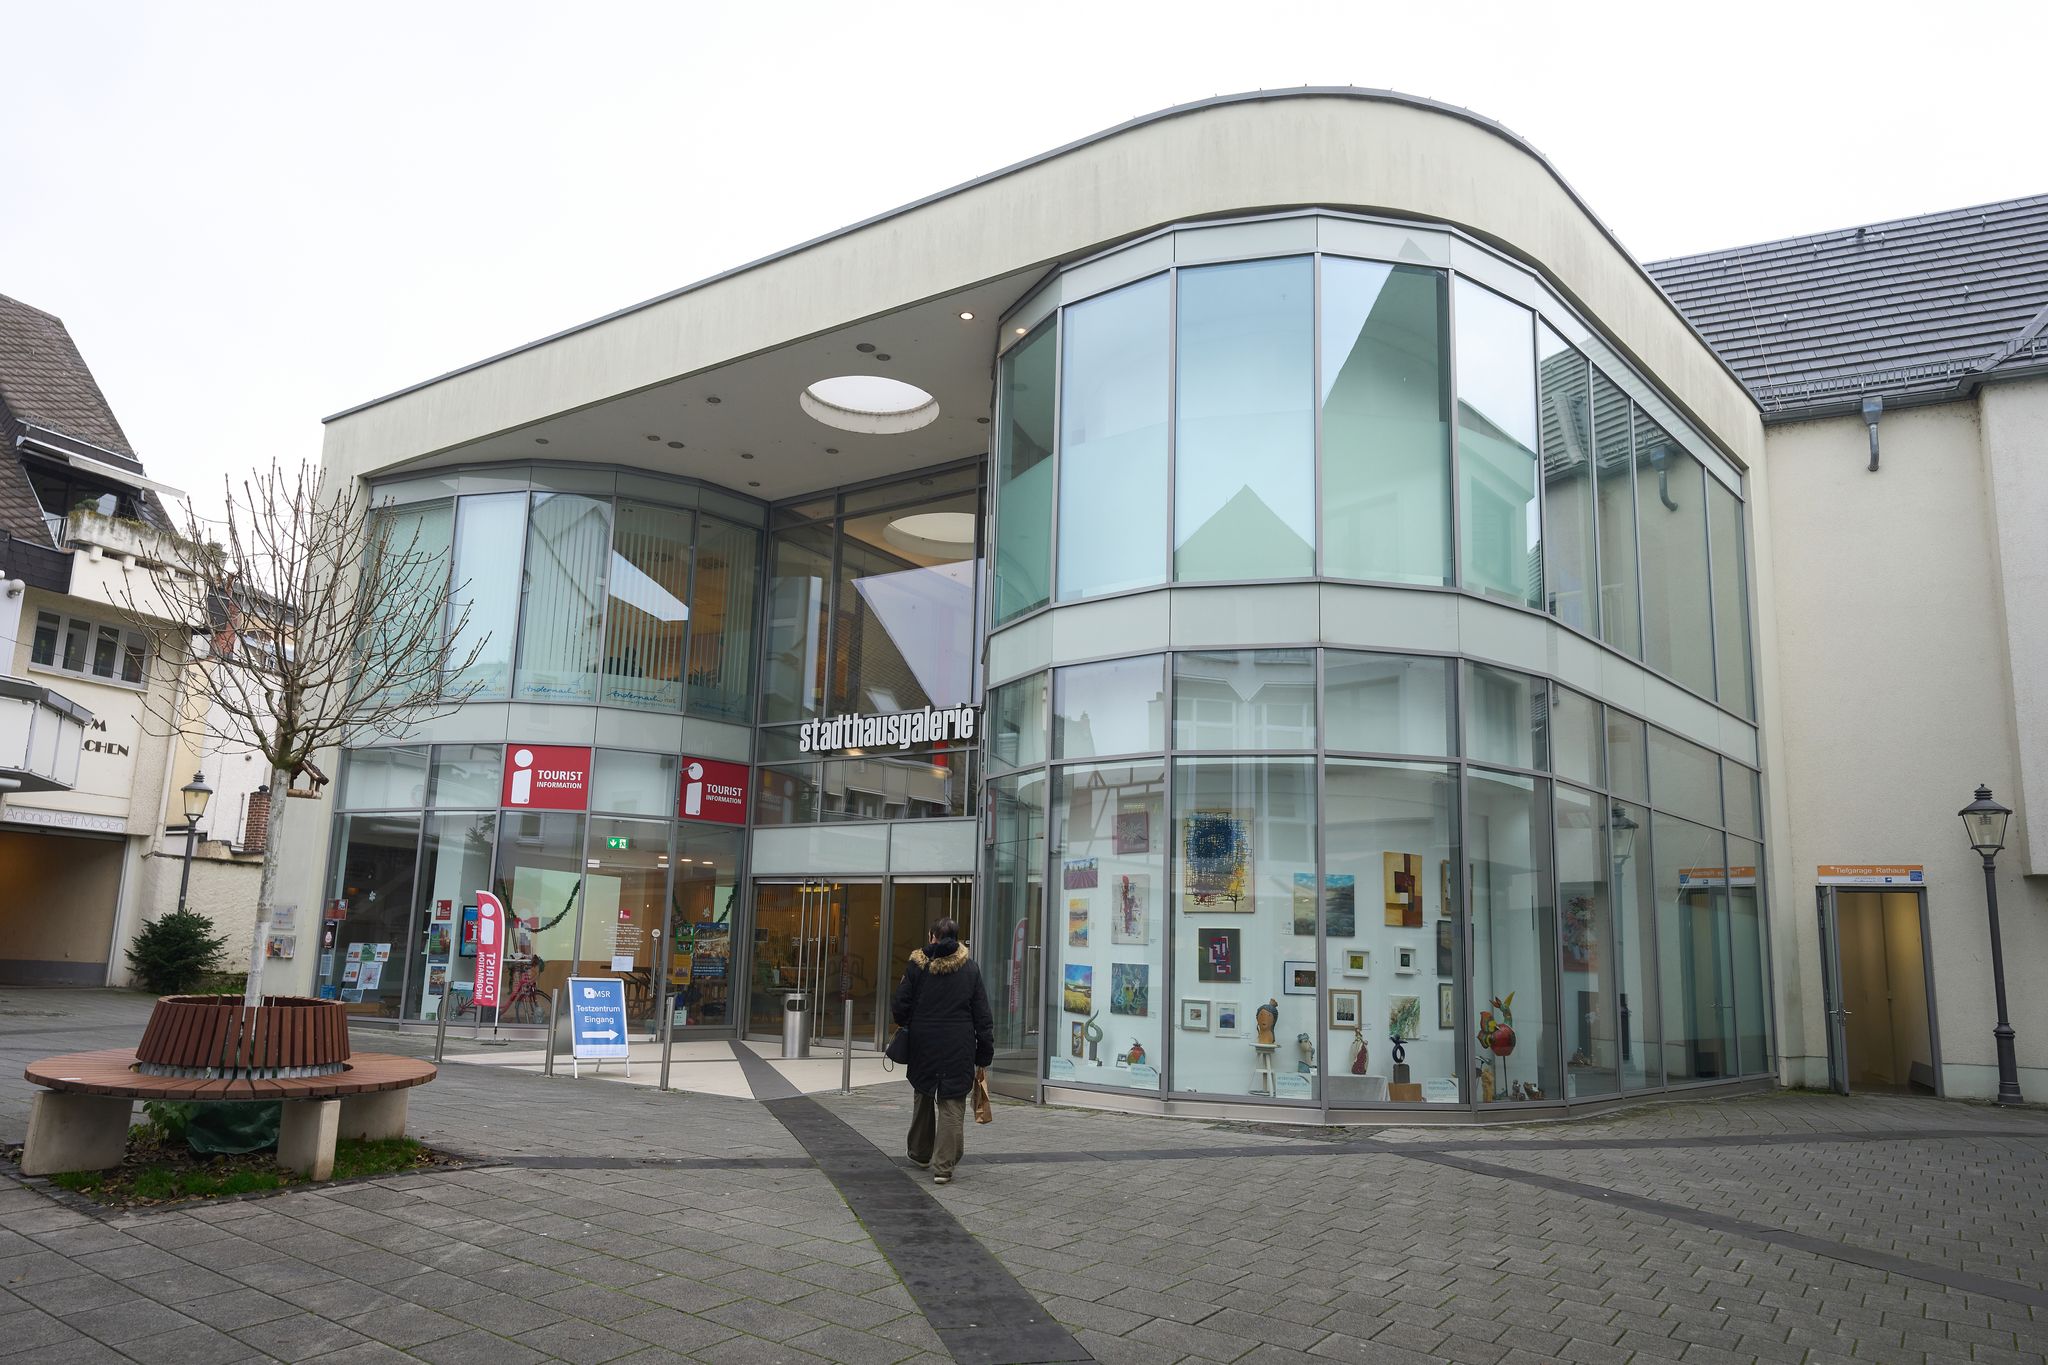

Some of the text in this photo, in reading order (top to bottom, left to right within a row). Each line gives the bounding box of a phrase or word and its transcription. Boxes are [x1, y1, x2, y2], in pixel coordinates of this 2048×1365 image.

[90, 717, 107, 732] M
[800, 702, 974, 753] stadthausgalerie
[81, 739, 129, 757] CHEN
[537, 769, 583, 781] TOURIST
[536, 781, 582, 789] INFORMATION
[706, 783, 743, 797] TOURIST
[705, 794, 742, 804] INFORMATION
[1835, 867, 1873, 875] Tiefgarage
[594, 990, 611, 998] MSR
[576, 1004, 621, 1013] Testzentrum
[584, 1015, 615, 1025] Eingang
